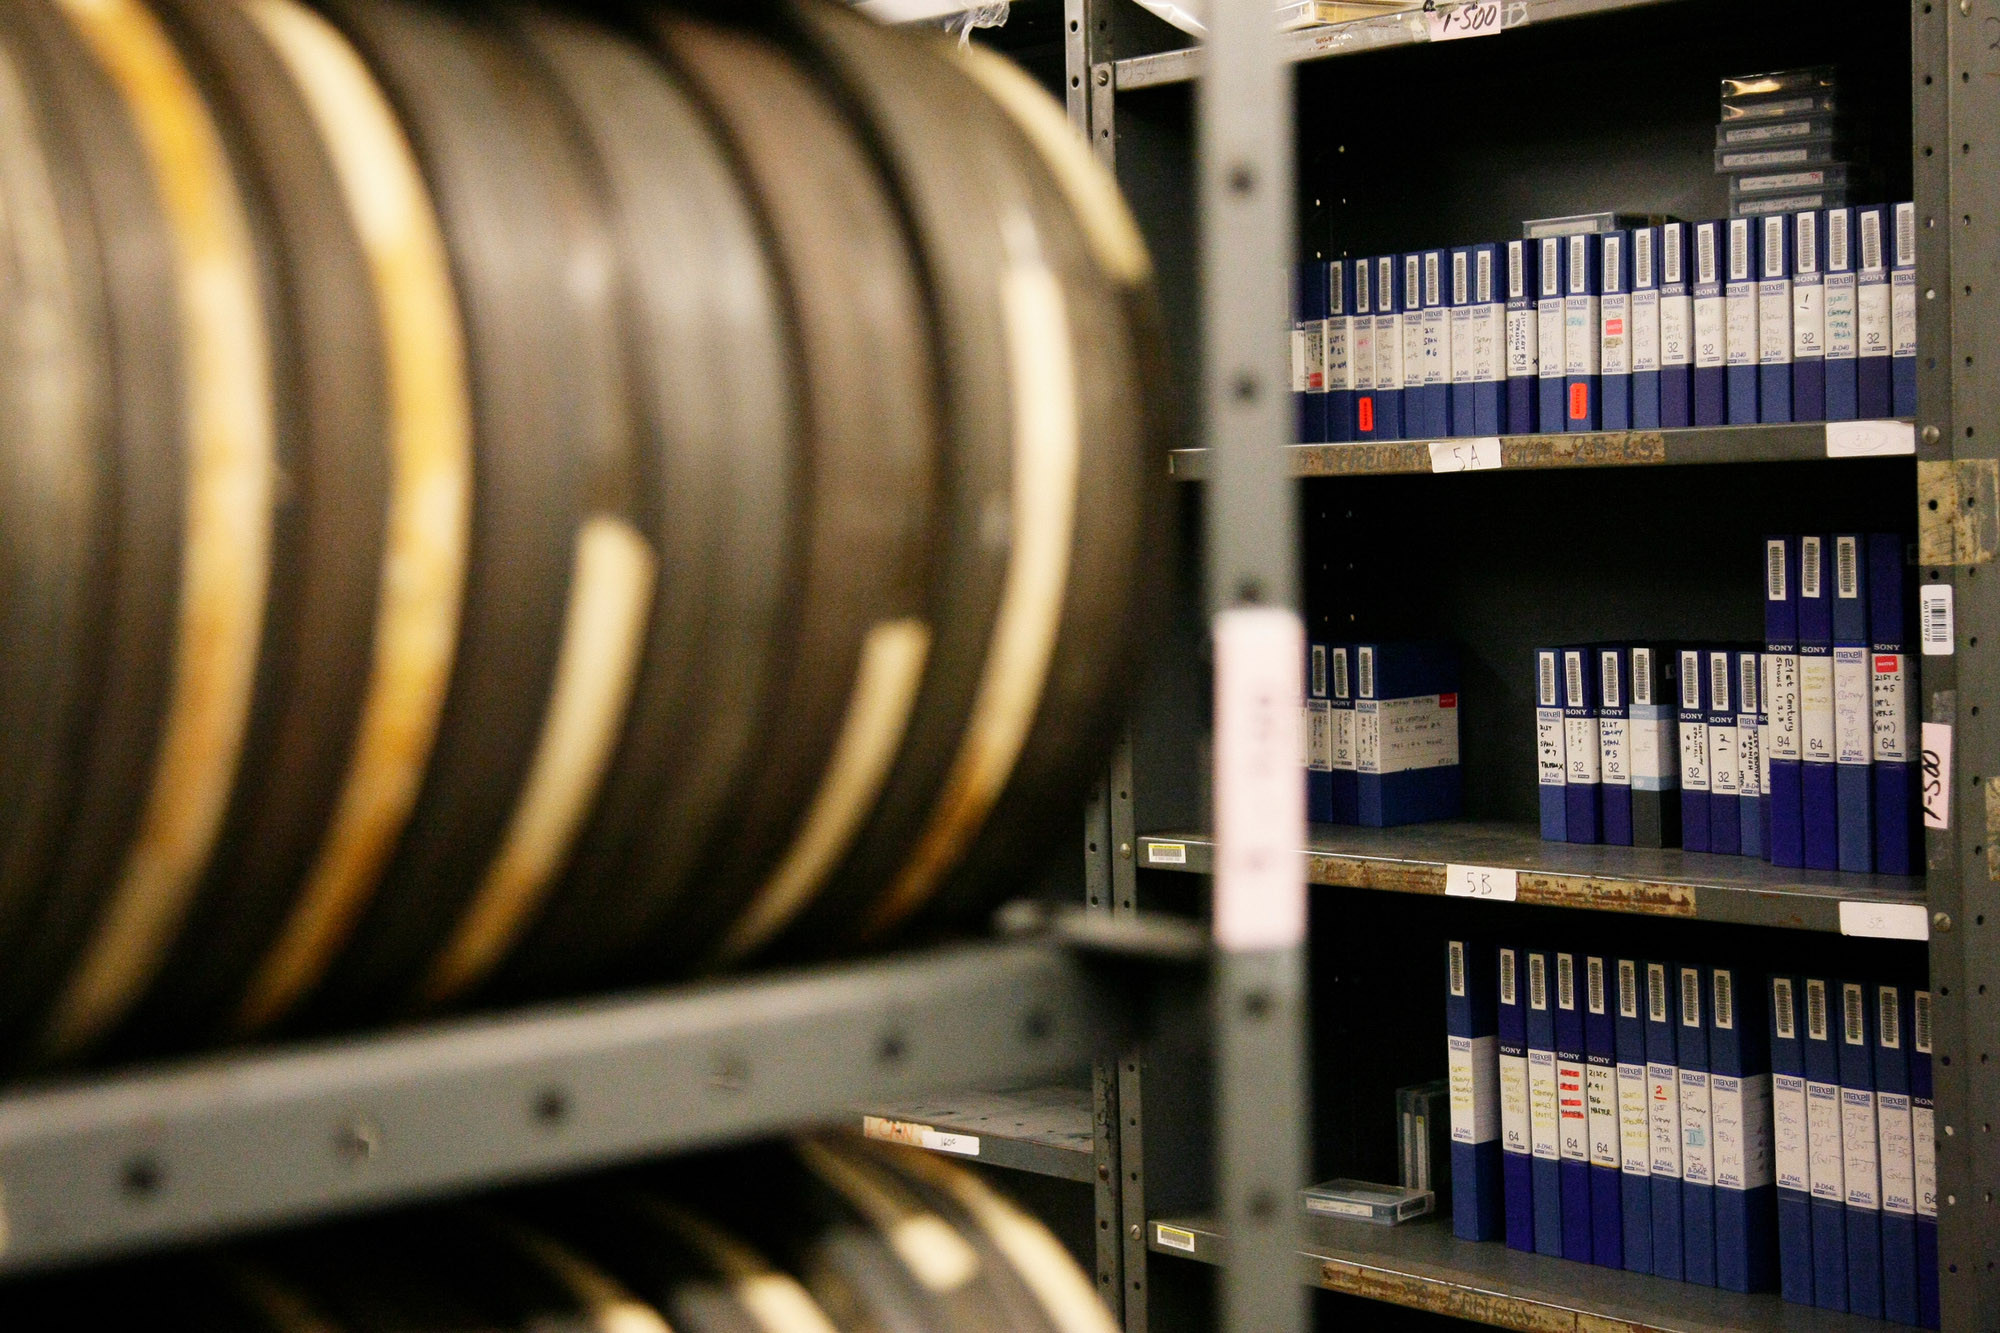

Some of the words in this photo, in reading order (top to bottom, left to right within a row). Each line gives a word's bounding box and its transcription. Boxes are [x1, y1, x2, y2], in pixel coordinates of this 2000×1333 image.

[1795, 275, 1819, 283] SONY
[1827, 275, 1854, 285] maxell
[1859, 274, 1886, 282] SONY
[1662, 286, 1684, 295] SONY
[1696, 287, 1718, 296] SONY
[1801, 332, 1815, 344] 32
[1866, 332, 1880, 344] 32
[1668, 342, 1680, 353] 32
[1703, 344, 1714, 355] 32
[1769, 644, 1794, 652] SONY
[1801, 646, 1827, 655] SONY
[1873, 643, 1901, 651] SONY
[1836, 651, 1863, 660] maxell
[1784, 692, 1797, 733] Century
[1777, 733, 1790, 745] 94
[1810, 738, 1824, 749] 64
[1881, 738, 1896, 750] 64
[1338, 749, 1348, 759] 32
[1573, 762, 1584, 773] 32
[1608, 762, 1620, 773] 32
[1688, 767, 1700, 779] 32
[1718, 771, 1730, 783] 32
[1500, 1045, 1521, 1054] SONY
[1559, 1051, 1580, 1060] SONY
[1588, 1055, 1610, 1064] SONY
[1619, 1066, 1642, 1076] maxell
[1649, 1066, 1673, 1076] maxell
[1681, 1073, 1706, 1083] maxell
[1713, 1077, 1738, 1088] maxell
[1776, 1077, 1802, 1089] maxell
[1655, 1085, 1663, 1095] 2
[1809, 1084, 1835, 1096] maxell
[1843, 1091, 1870, 1103] maxell
[1880, 1096, 1907, 1105] maxell
[1508, 1131, 1520, 1142] 64
[1566, 1137, 1578, 1149] 64
[1597, 1142, 1609, 1154] 64
